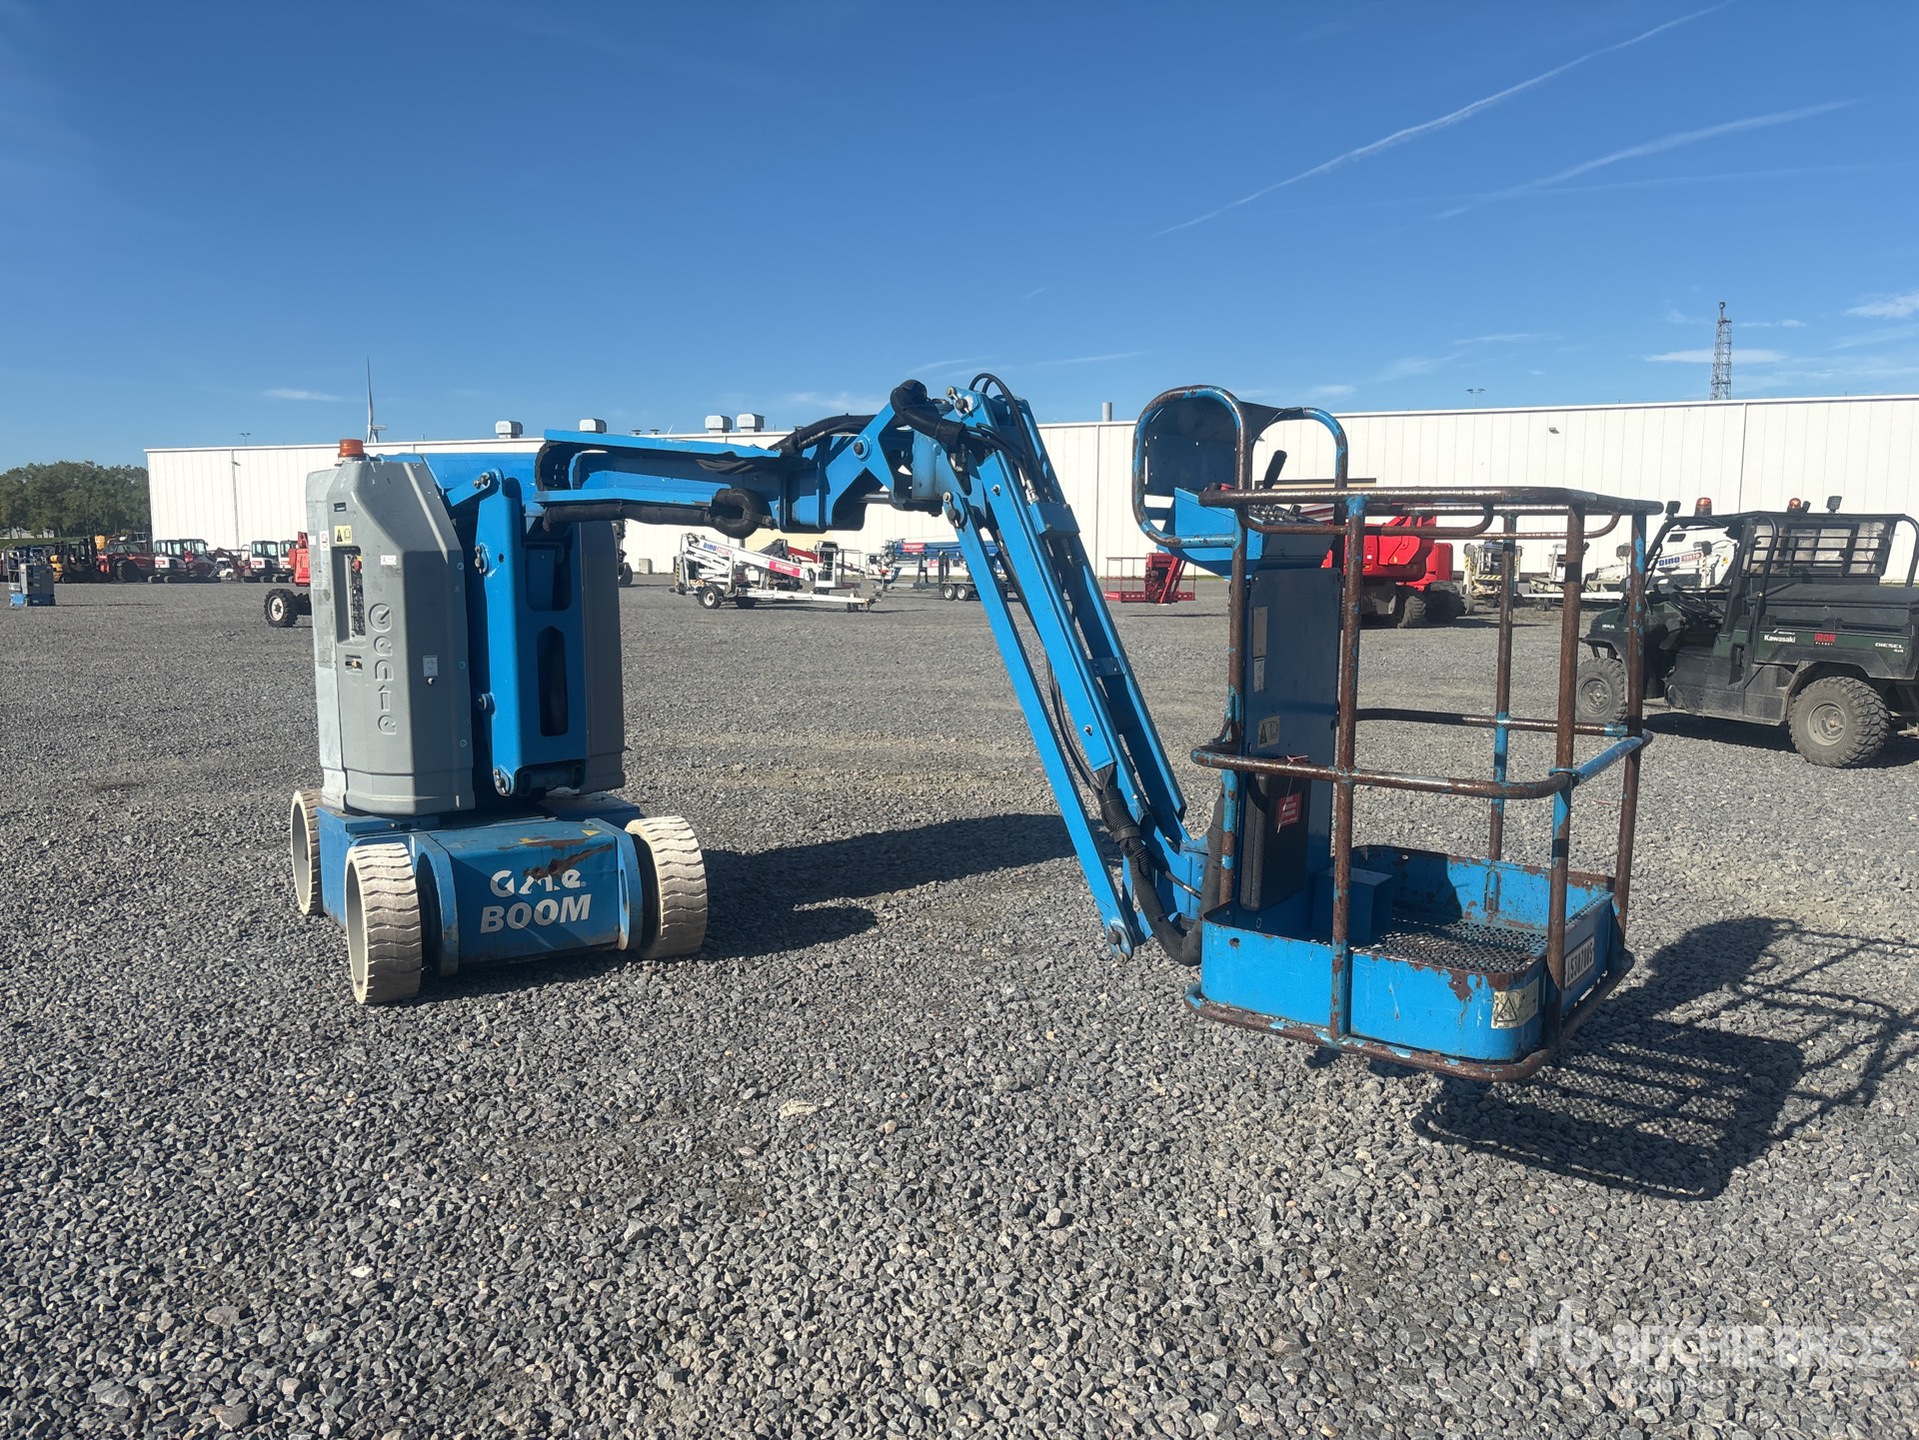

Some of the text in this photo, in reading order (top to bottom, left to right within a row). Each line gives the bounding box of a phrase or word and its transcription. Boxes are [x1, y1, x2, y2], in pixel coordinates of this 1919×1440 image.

[1659, 556, 1680, 566] DINO
[1764, 634, 1796, 643] Kawasaki
[1814, 633, 1836, 642] IRON
[369, 602, 397, 736] Genie
[480, 893, 592, 934] BOOM
